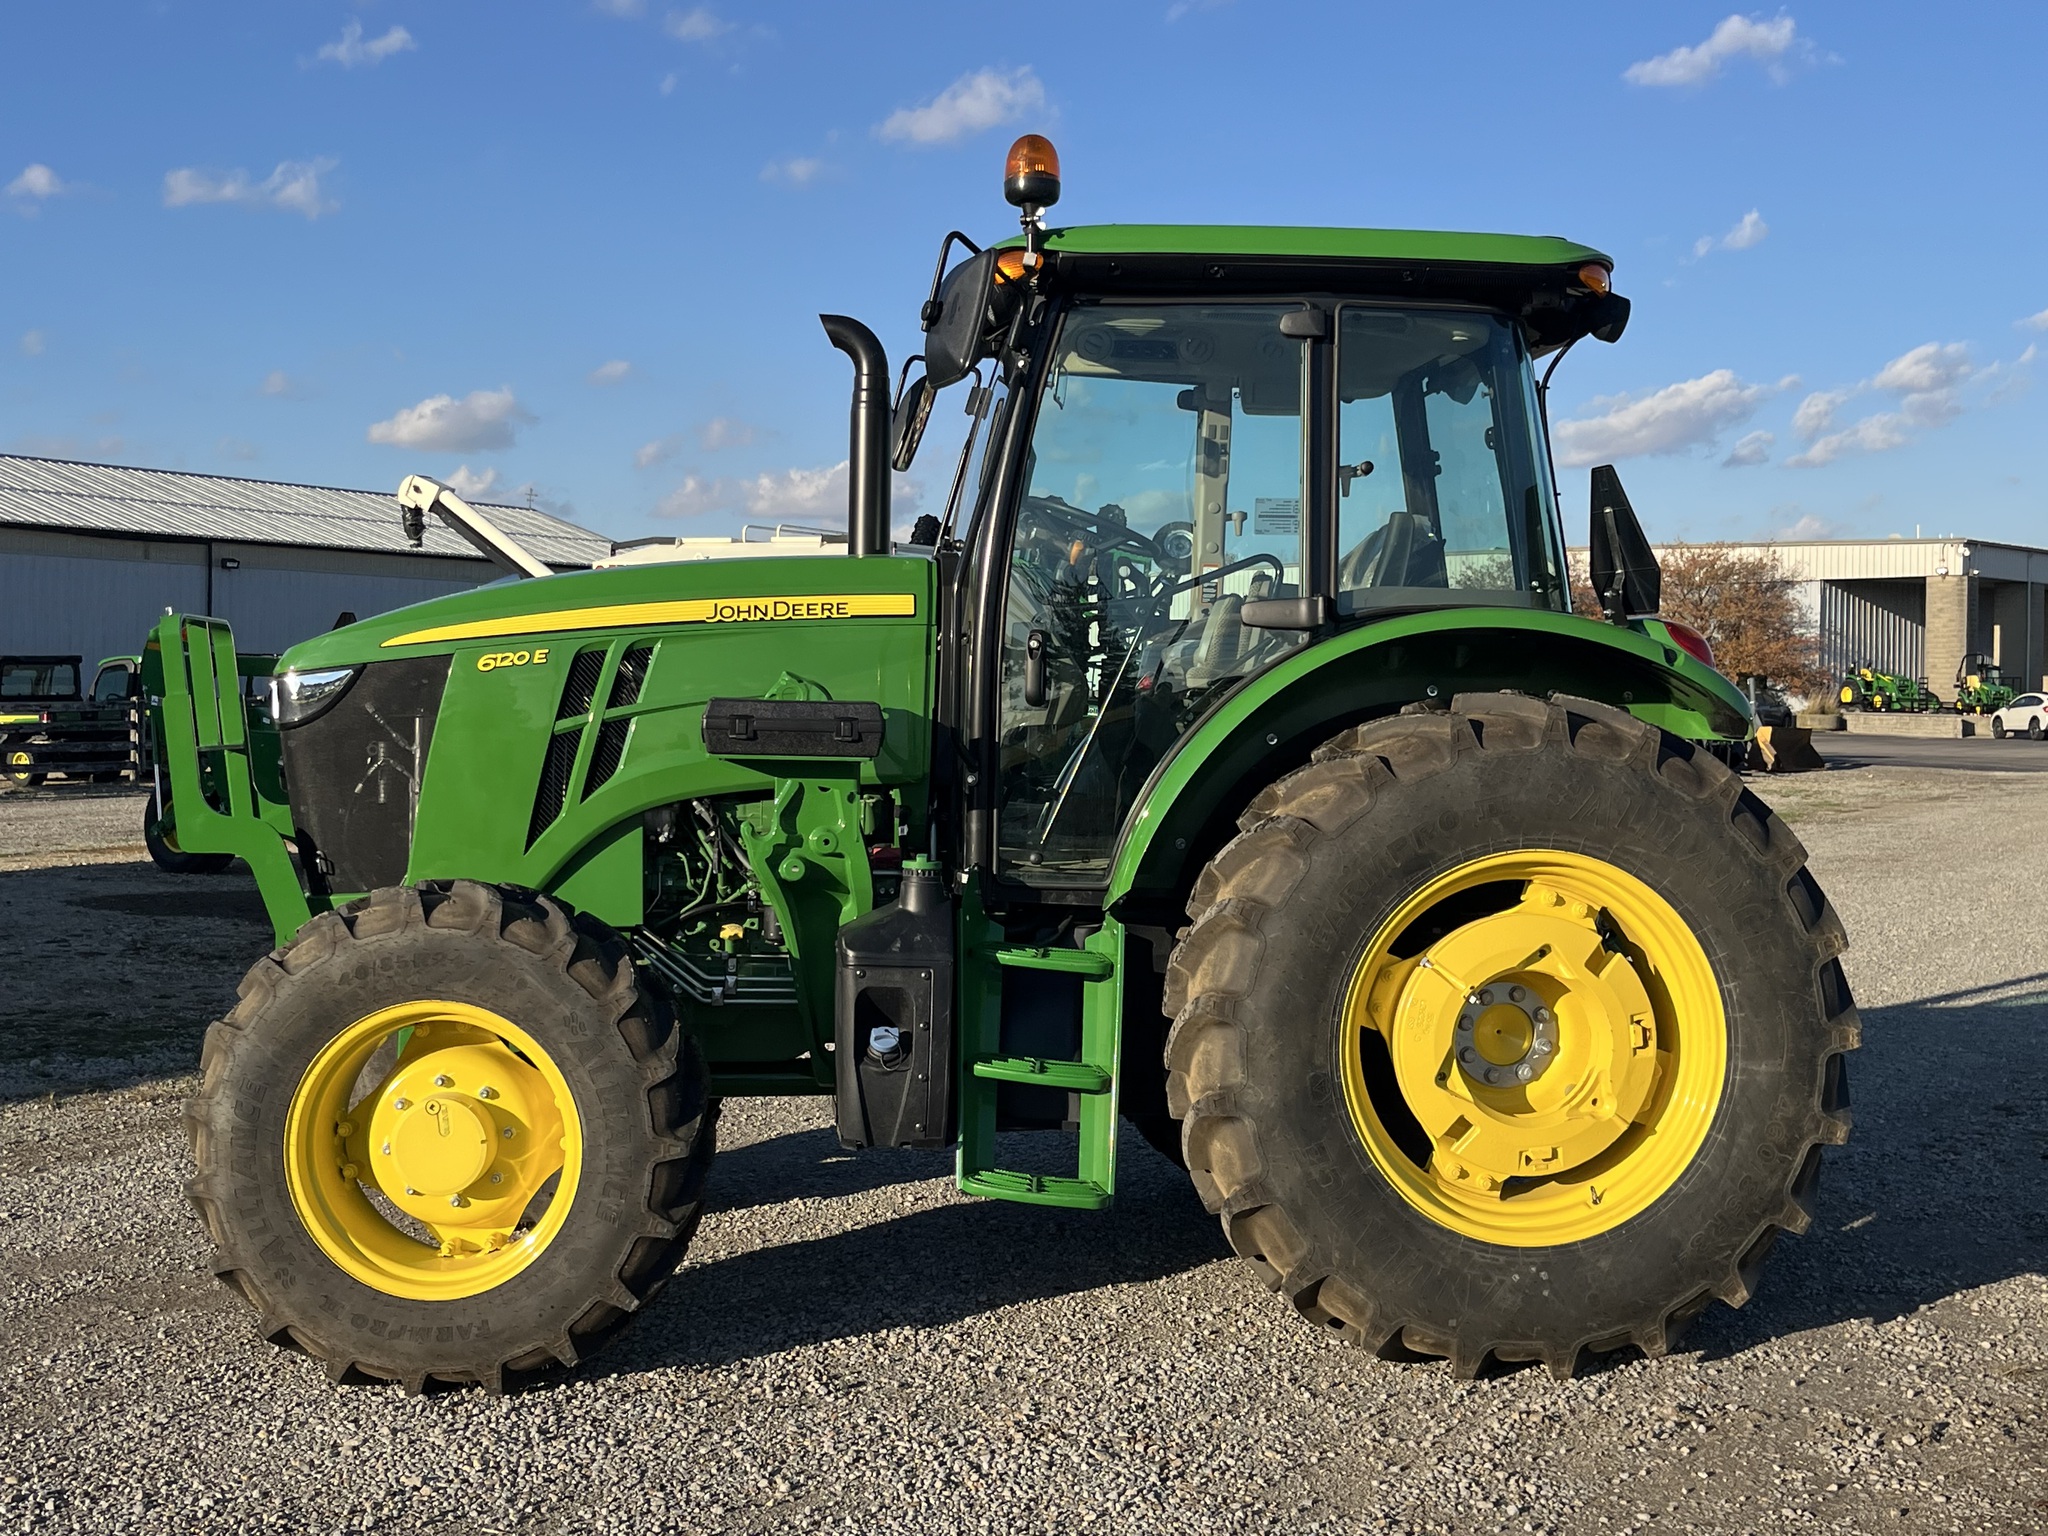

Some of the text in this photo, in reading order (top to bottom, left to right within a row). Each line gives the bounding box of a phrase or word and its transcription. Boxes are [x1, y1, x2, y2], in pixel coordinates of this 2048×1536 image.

[477, 648, 550, 672] 6120 E
[706, 601, 848, 620] JOHN DEERE
[1566, 785, 1784, 962] ALLIANCE
[231, 1077, 297, 1267] ALLIANCE
[566, 1036, 632, 1228] ALLIANCE
